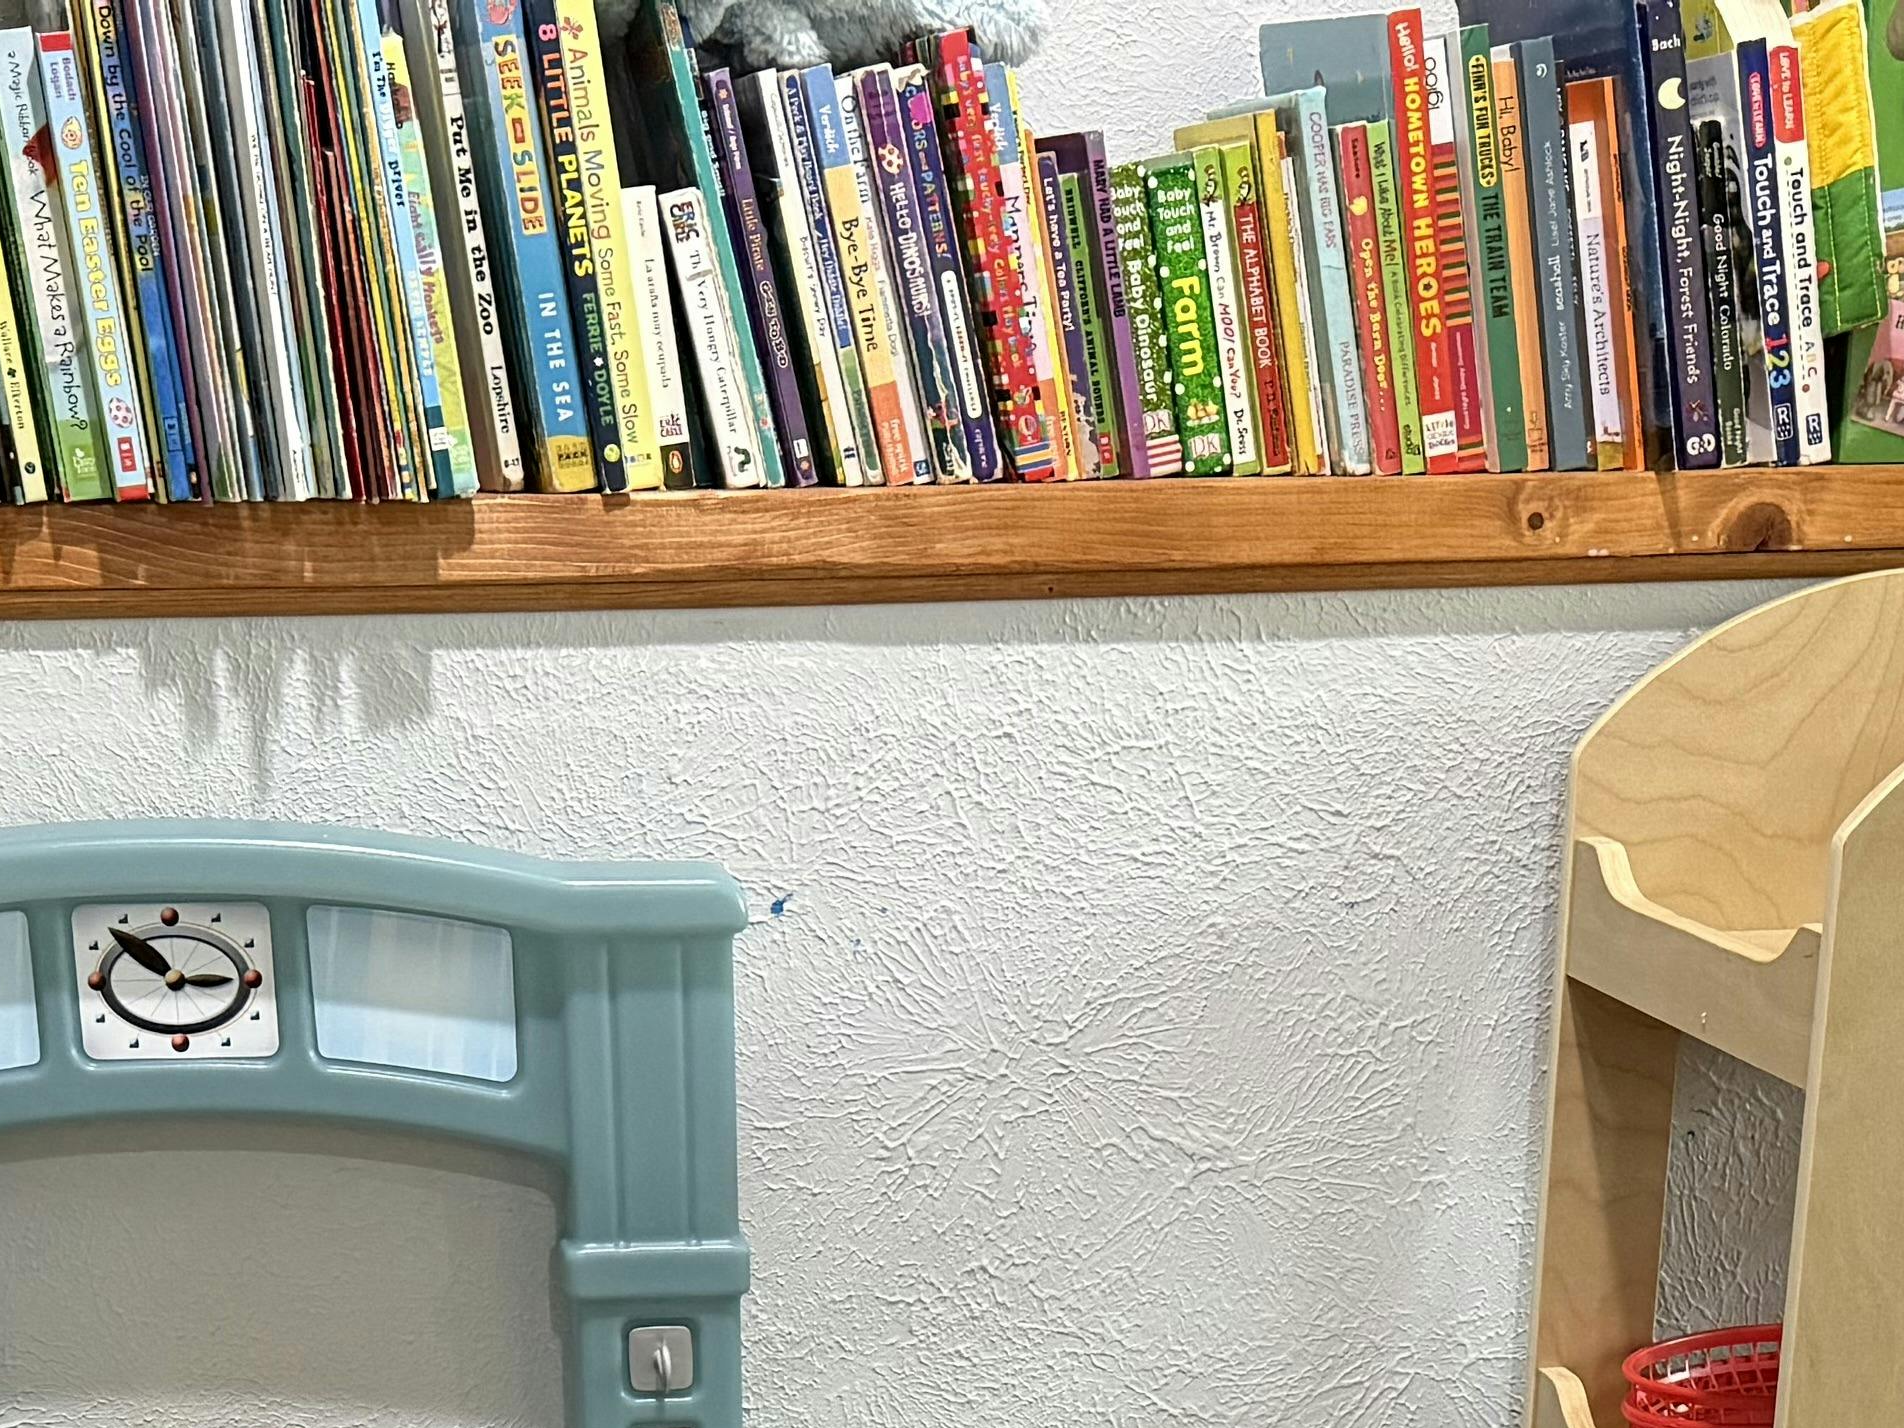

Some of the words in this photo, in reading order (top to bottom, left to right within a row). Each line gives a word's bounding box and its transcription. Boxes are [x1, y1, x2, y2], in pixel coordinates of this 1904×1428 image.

[98, 6, 115, 58] Down
[538, 23, 558, 42] 8
[1395, 20, 1421, 72] Hello!
[106, 61, 121, 87] by
[1471, 63, 1488, 103] FINN'S
[111, 92, 126, 120] the
[542, 53, 573, 145] LITTLE
[1474, 105, 1489, 131] FUN
[115, 129, 136, 169] Cool
[450, 115, 466, 158] Put
[1308, 111, 1326, 167] COOPER
[1403, 76, 1430, 209] HOMETOWN
[1478, 132, 1495, 179] TRUCKS
[68, 160, 91, 214] Ten
[127, 176, 141, 193] of
[457, 166, 474, 199] Me
[1044, 178, 1056, 211] Let's
[1093, 159, 1104, 193] MARY
[1157, 188, 1191, 203] Baby
[1318, 168, 1329, 193] HAS
[128, 199, 142, 227] the
[557, 153, 594, 278] PLANETS
[1098, 196, 1110, 224] HAD
[1157, 204, 1195, 220] Touch
[1321, 196, 1332, 216] BIG
[1482, 192, 1500, 221] THE
[1666, 135, 1694, 265] Night-Night,
[31, 190, 56, 252] What
[463, 210, 478, 233] in
[1049, 214, 1061, 248] have
[1103, 228, 1109, 237] A
[1166, 222, 1192, 237] and
[1239, 214, 1255, 243] THE
[1324, 219, 1337, 249] EARS
[1712, 214, 1725, 251] Good
[78, 217, 110, 312] Easter
[135, 235, 153, 271] Pool
[470, 243, 487, 283] the
[1055, 252, 1062, 260] a
[1104, 240, 1120, 281] LITTLE
[1167, 237, 1195, 254] Feel
[1484, 226, 1504, 274] TRAIN
[41, 256, 64, 322] Makes
[841, 217, 869, 298] Bye-Bye
[858, 304, 878, 352] Time
[1057, 263, 1068, 287] Tea
[1243, 249, 1266, 323] ALPHABET
[1412, 216, 1442, 338] HEROES
[1585, 233, 1603, 305] Nature's
[1714, 255, 1730, 299] Night
[537, 292, 557, 317] IN
[1060, 290, 1074, 331] Party!
[1111, 280, 1125, 317] LAMB
[1490, 276, 1509, 319] TEAM
[1677, 267, 1693, 319] Forest
[54, 325, 67, 337] a
[478, 292, 494, 336] Zoo
[1126, 259, 1143, 309] Baby
[1135, 314, 1158, 402] Dinosaur
[1171, 276, 1204, 376] Farm
[96, 317, 122, 388] Eggs
[544, 330, 565, 369] THE
[1254, 327, 1273, 369] BOOK
[1593, 308, 1612, 396] Architects
[1682, 322, 1699, 384] Friends
[1719, 303, 1734, 371] Colorado
[582, 292, 603, 355] FERRIE
[593, 371, 614, 427] DOYLE
[57, 341, 88, 431] Rainbow?
[491, 365, 510, 434] Lopshire
[552, 381, 574, 422] SEA
[1339, 341, 1358, 412] PARADISE
[1350, 412, 1365, 455] PRESS
[1233, 409, 1244, 426] Dr.
[1191, 435, 1220, 456] DK
[1237, 427, 1248, 455] Seuss
